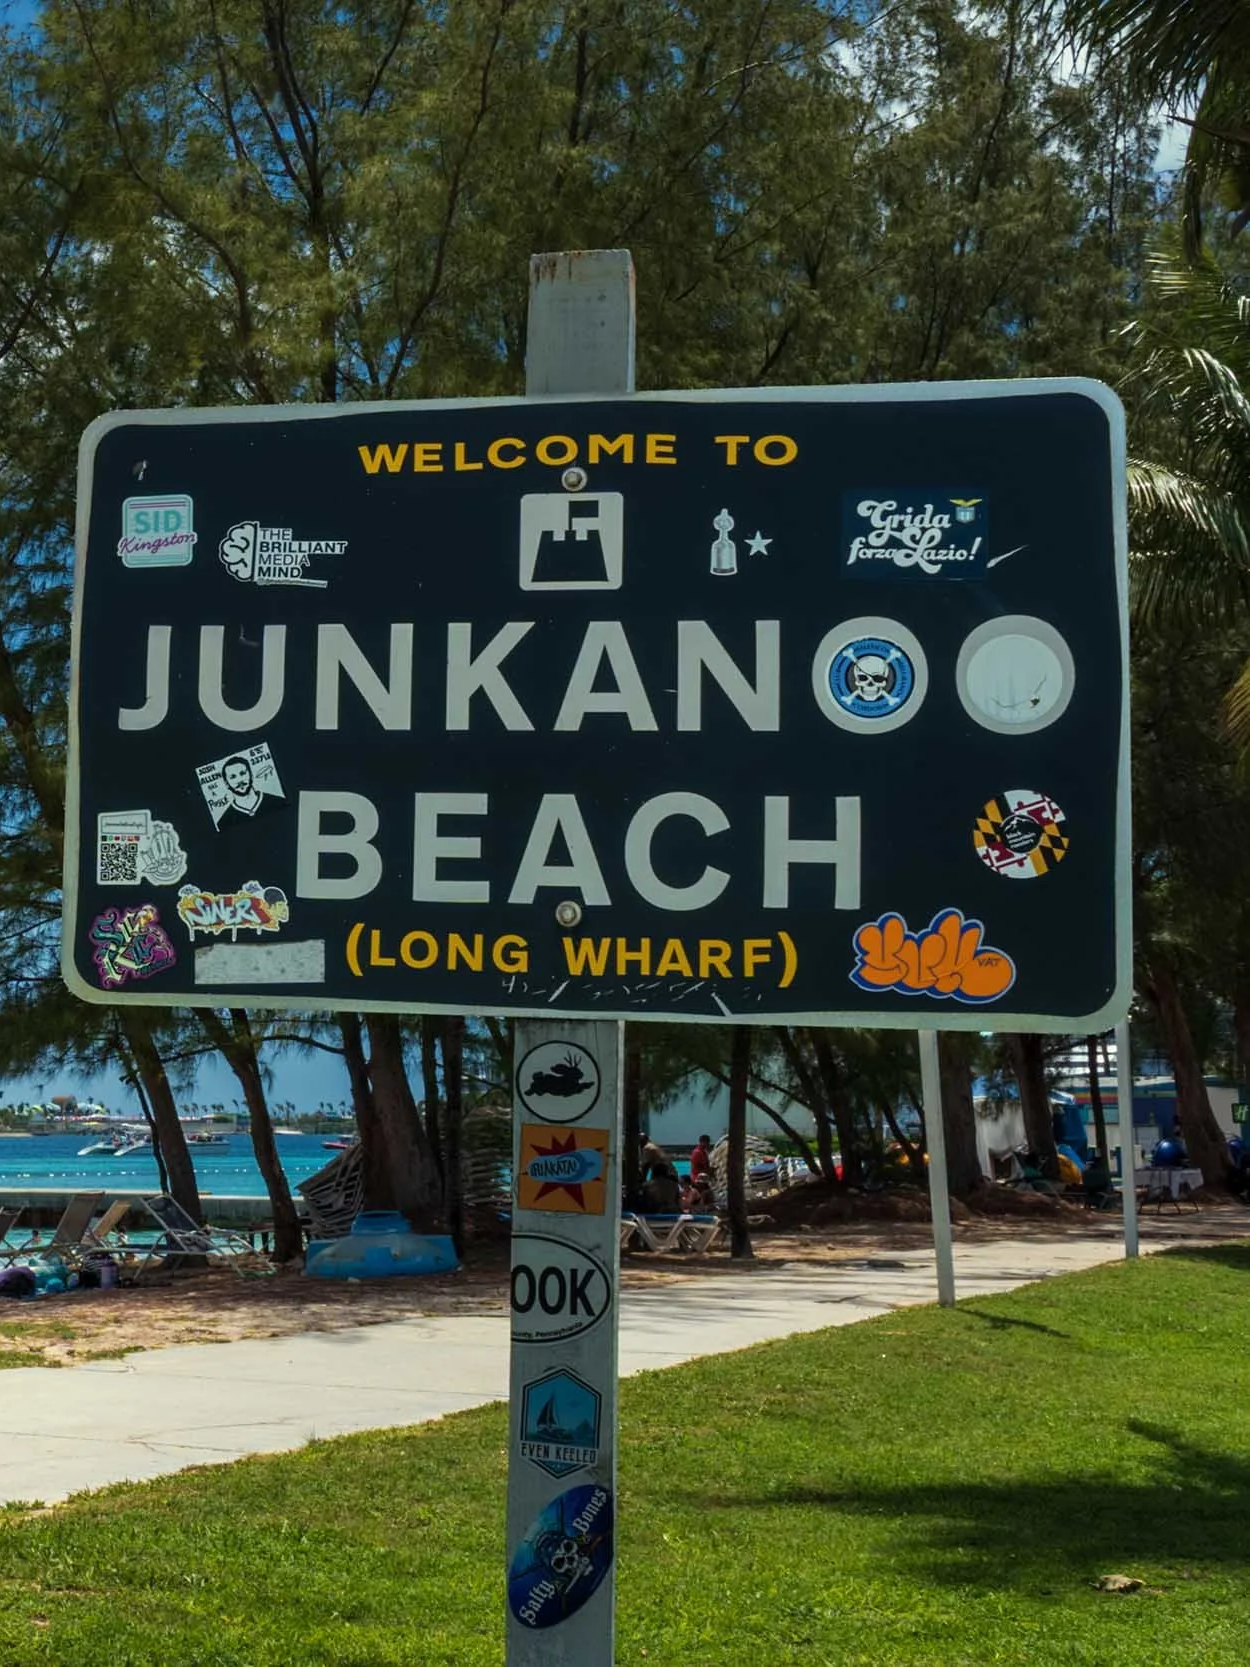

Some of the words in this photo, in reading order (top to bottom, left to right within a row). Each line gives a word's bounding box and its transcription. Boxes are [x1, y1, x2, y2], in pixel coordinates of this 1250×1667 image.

[358, 433, 677, 475] WELCOME
[715, 435, 798, 466] TO
[134, 510, 182, 533] SID
[260, 528, 291, 541] THE
[857, 500, 952, 547] Grida
[119, 531, 196, 554] Kingston
[259, 541, 347, 553] BRILLIANT
[846, 536, 897, 566] forza
[893, 526, 982, 574] Lazio!
[258, 553, 310, 566] MEDIA
[258, 566, 302, 579] MIND
[118, 614, 1076, 736] JUNKANOO
[199, 771, 223, 786] ALLEN
[295, 790, 861, 911] BEACH
[346, 922, 528, 977] (LONG
[562, 931, 797, 989] WHARF)
[511, 1263, 597, 1316] OOK
[521, 1442, 550, 1459] EVEN
[555, 1446, 597, 1464] KEELED
[519, 1579, 556, 1626] Salty
[572, 1487, 608, 1535] Bones
